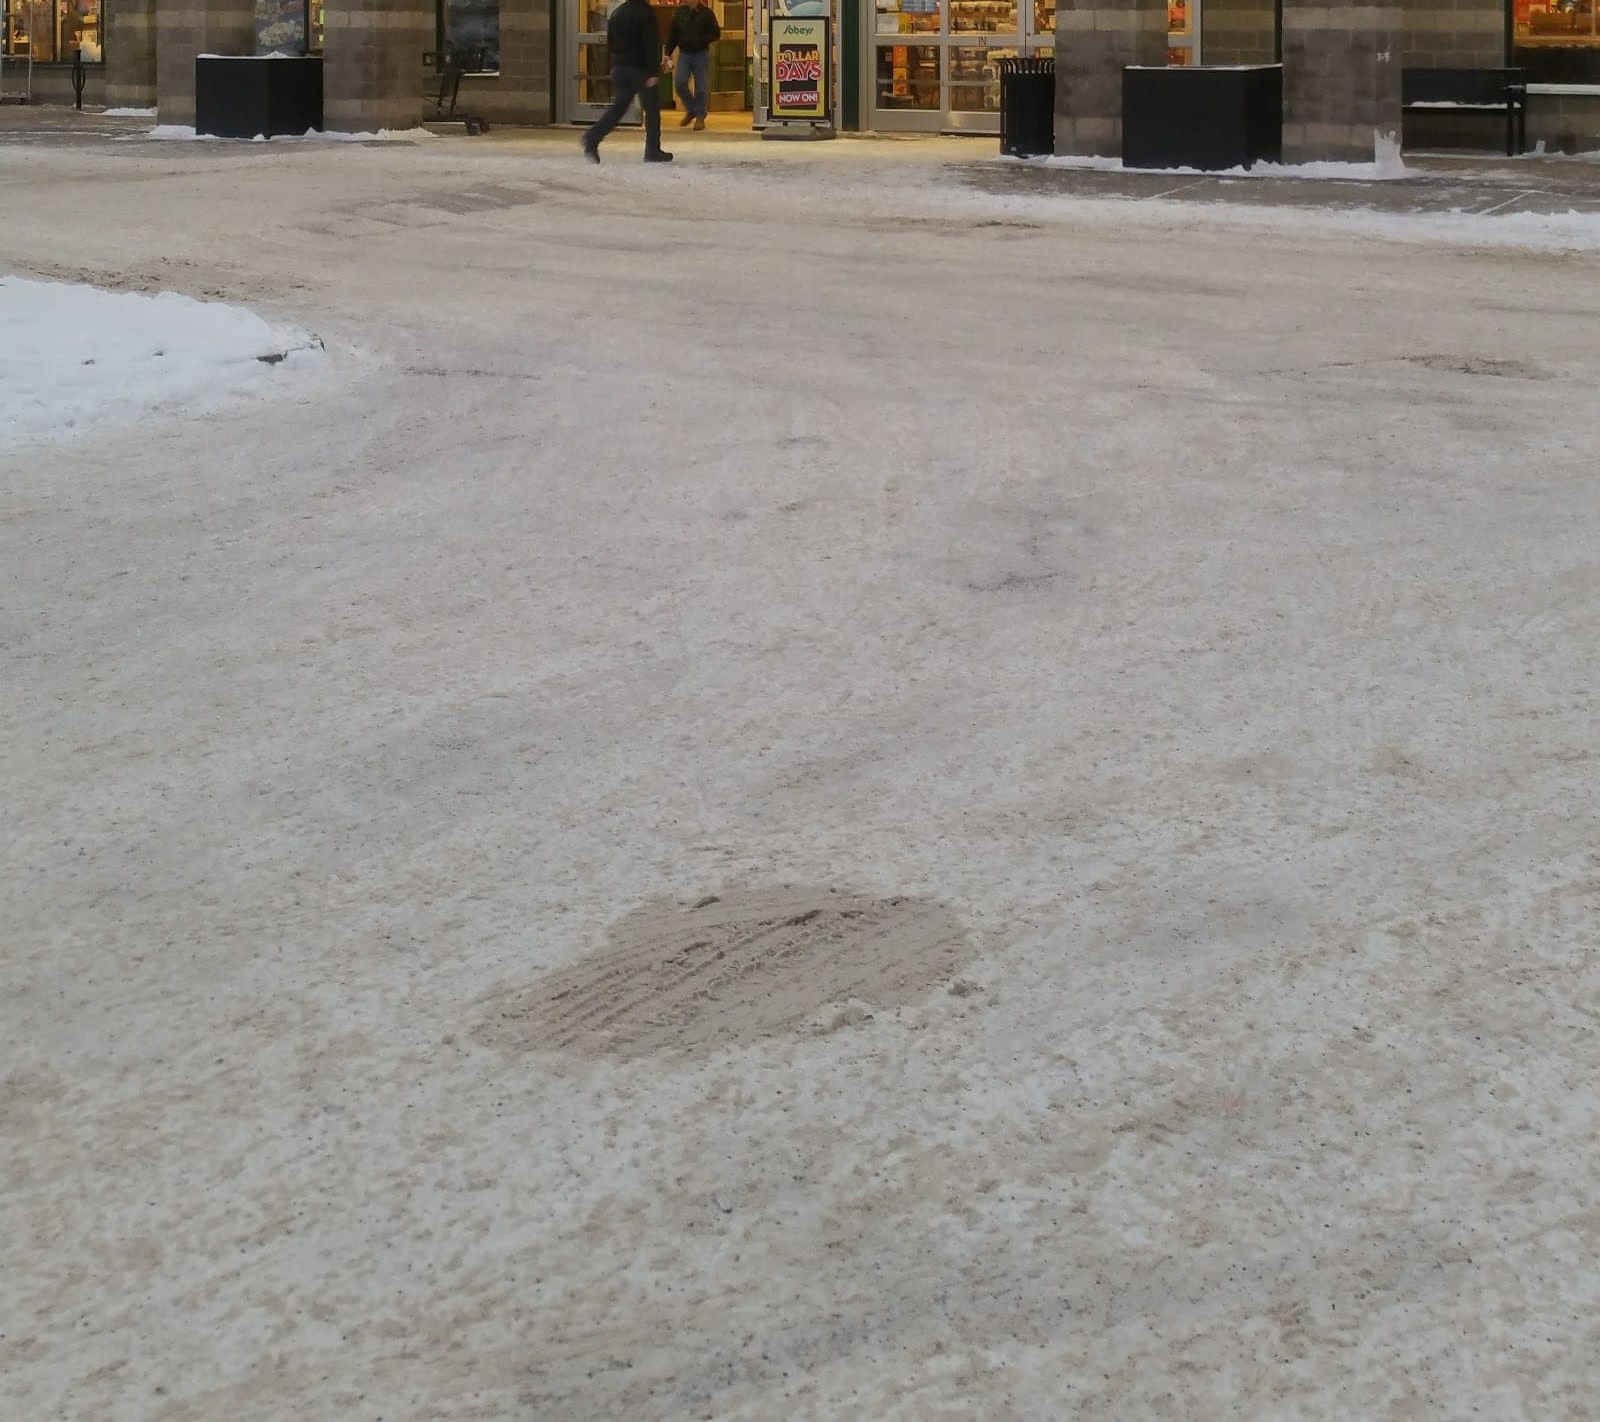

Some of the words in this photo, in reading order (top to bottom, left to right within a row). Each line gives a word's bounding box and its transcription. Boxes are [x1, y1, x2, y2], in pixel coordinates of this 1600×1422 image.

[783, 25, 814, 36] Sobeys
[777, 49, 820, 64] DOLLAR
[776, 62, 822, 81] DAYS
[779, 94, 800, 103] NOW
[801, 93, 818, 102] ON!
